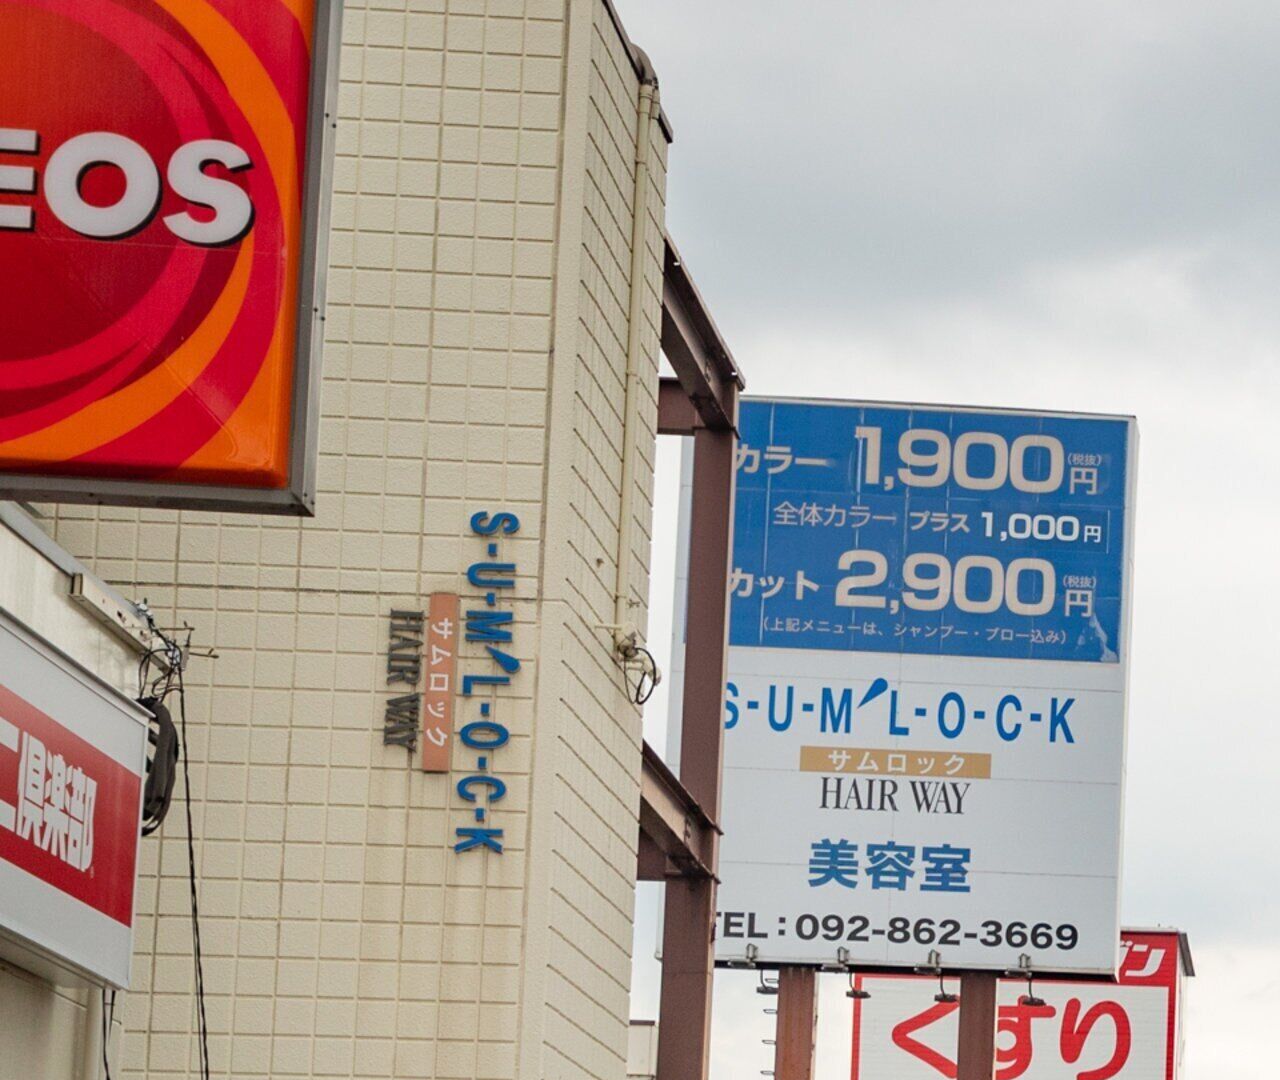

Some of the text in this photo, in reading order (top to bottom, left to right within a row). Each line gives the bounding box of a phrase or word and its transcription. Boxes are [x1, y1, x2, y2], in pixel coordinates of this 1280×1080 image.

[736, 443, 828, 475] カラー
[772, 501, 898, 528] 全体カラー
[909, 511, 971, 534] プラス
[729, 570, 820, 601] カット
[383, 608, 424, 753] HAIR WAY
[426, 617, 453, 747] サムロック
[828, 749, 968, 774] サムロック
[819, 777, 971, 815] HAIR WAY
[808, 838, 972, 894] 美容室
[795, 914, 1079, 950] 092-862-3669
